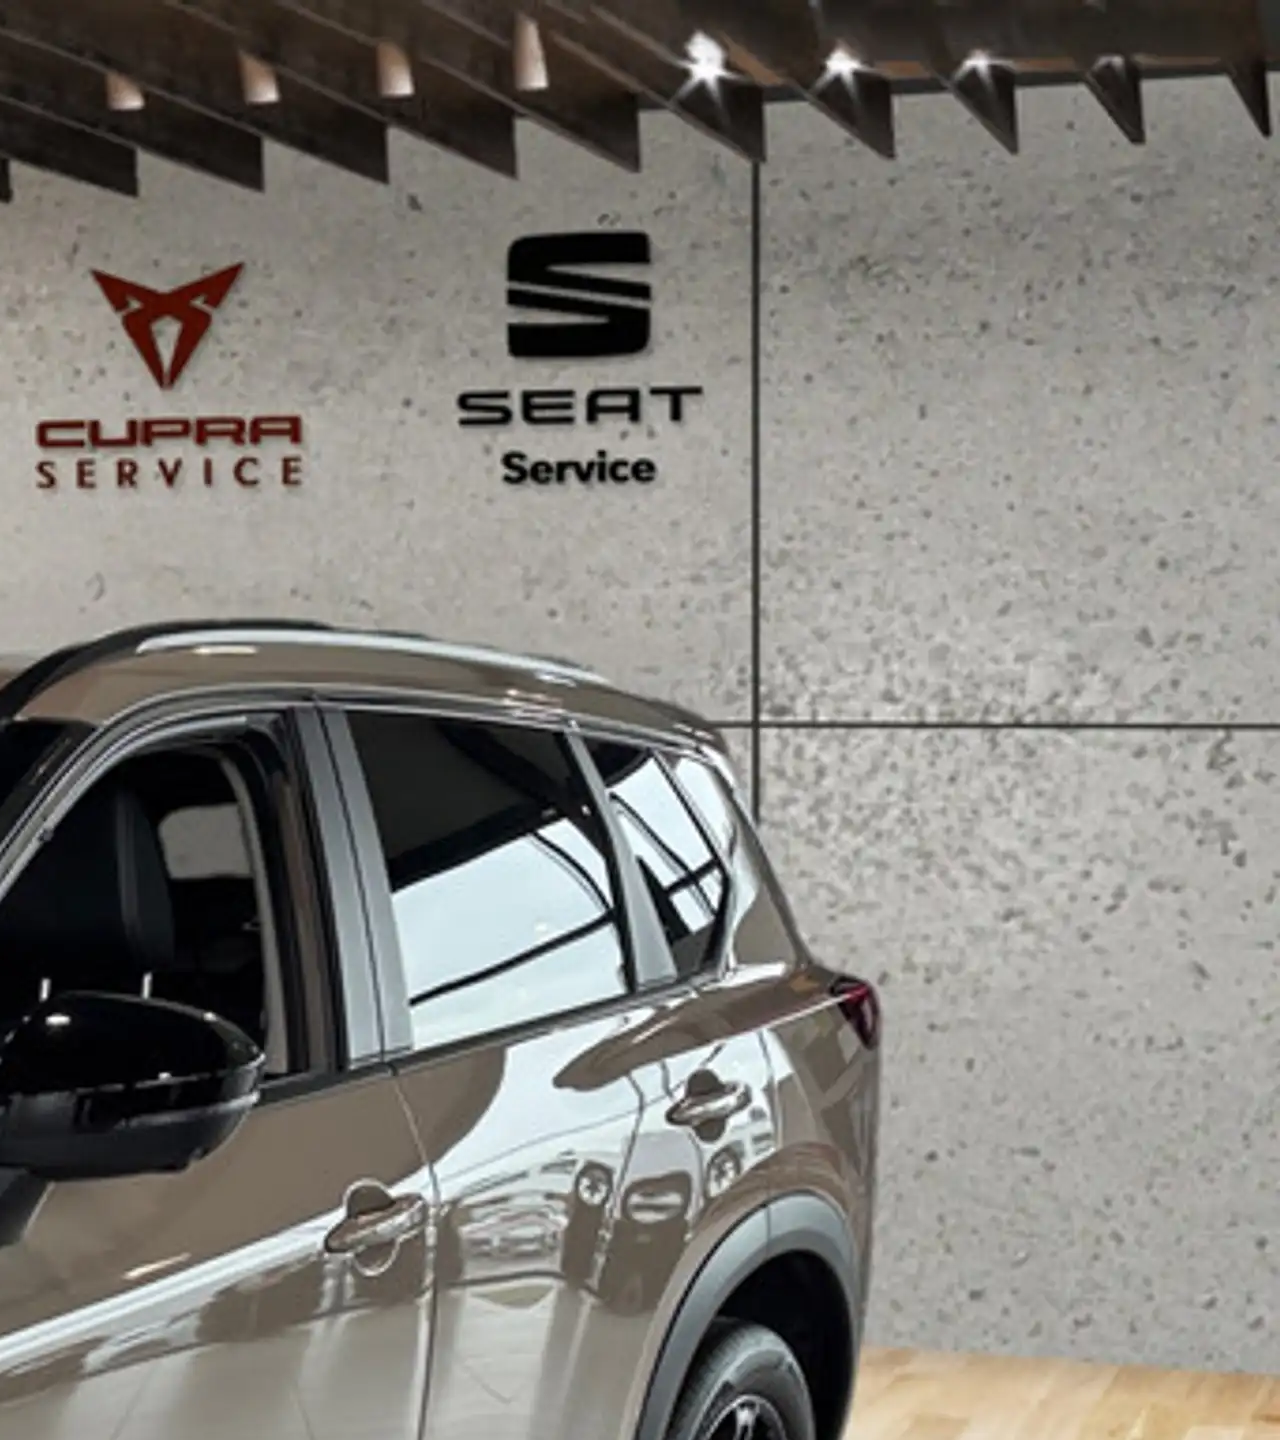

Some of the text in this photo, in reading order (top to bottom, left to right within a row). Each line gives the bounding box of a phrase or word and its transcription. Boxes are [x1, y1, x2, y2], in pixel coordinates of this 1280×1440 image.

[456, 385, 704, 427] SEAT
[35, 415, 305, 448] CUPRA
[35, 455, 305, 489] SERVICE
[500, 449, 657, 485] Service
